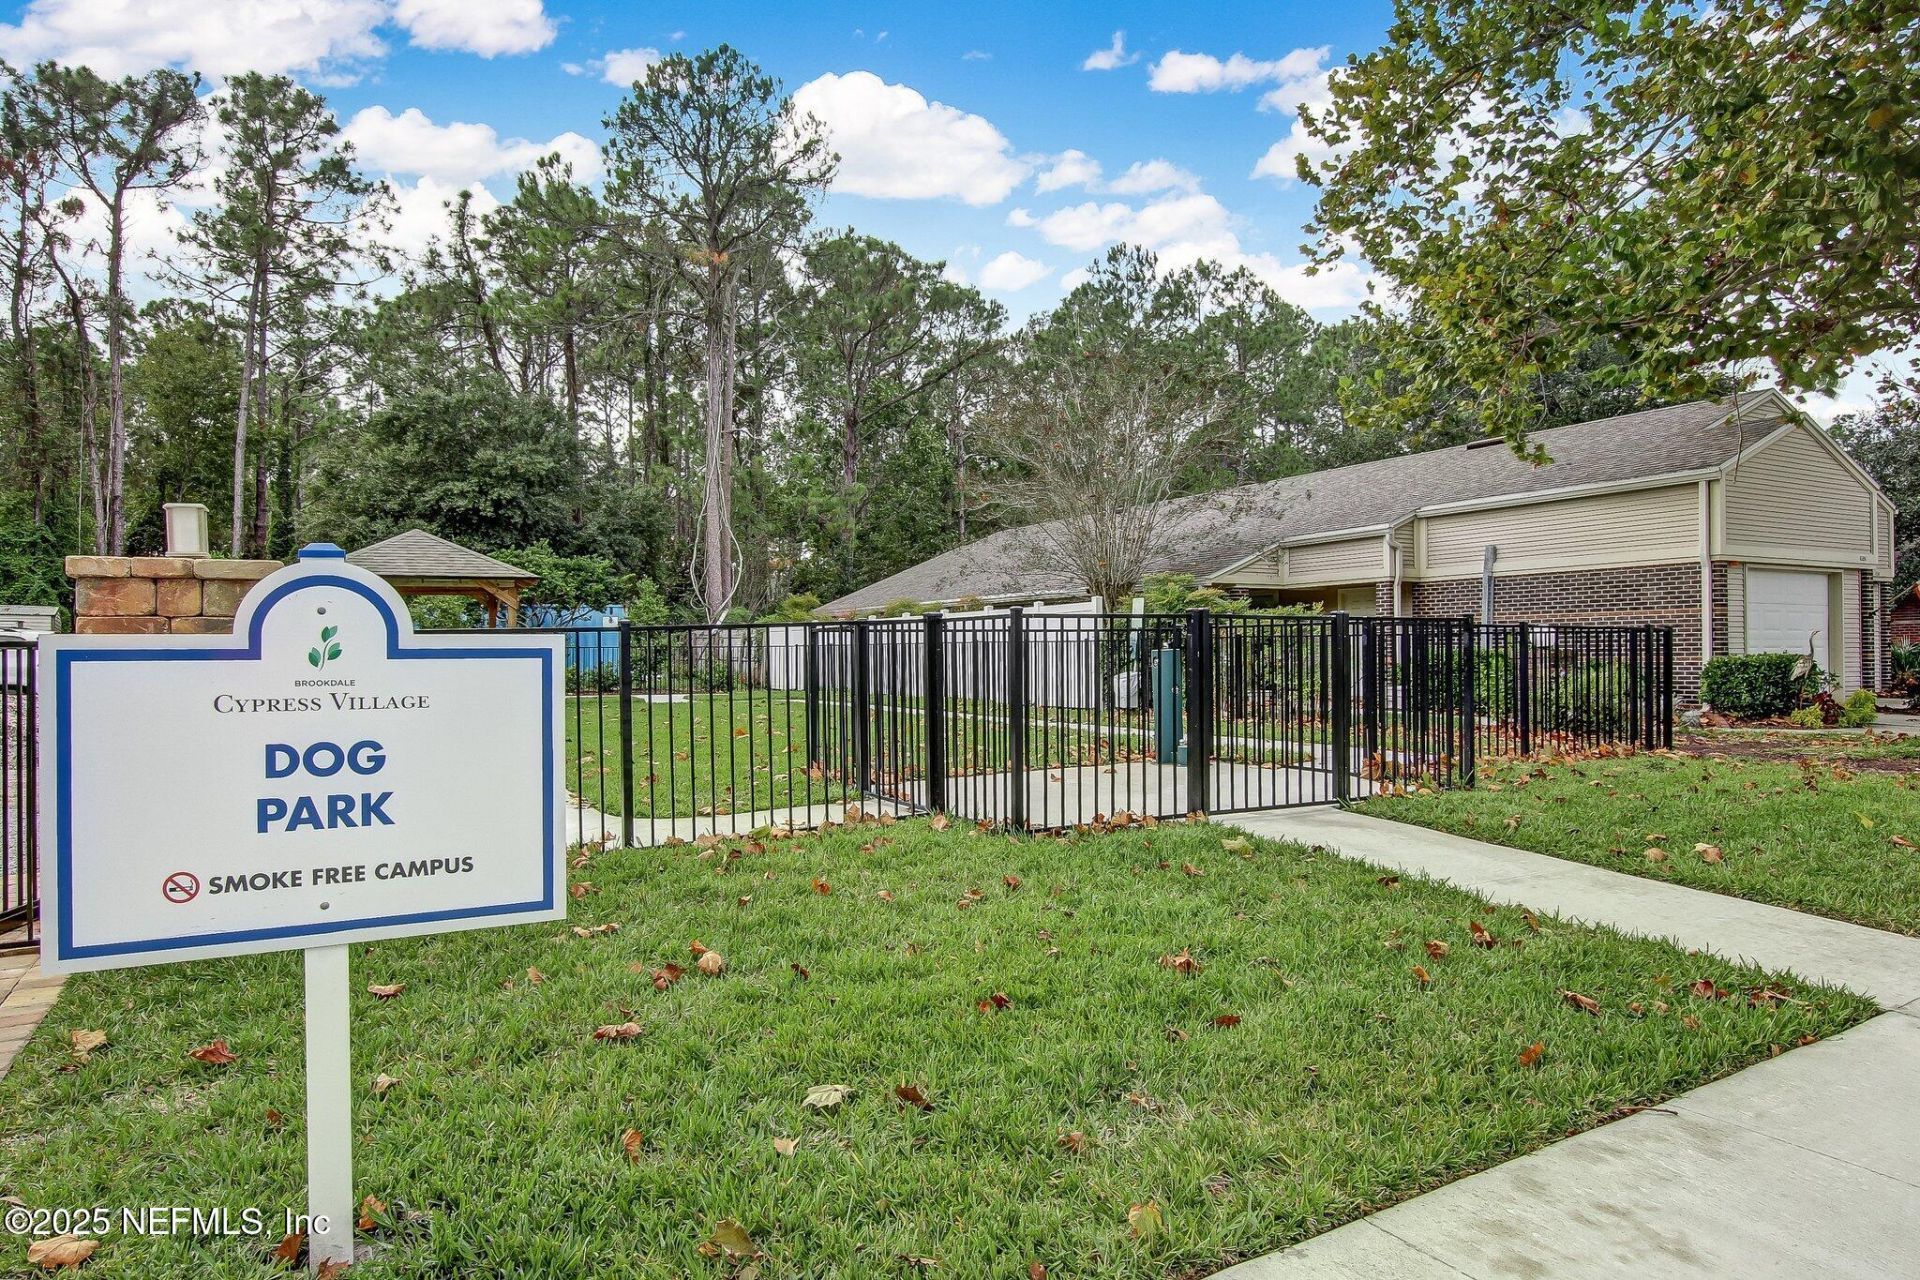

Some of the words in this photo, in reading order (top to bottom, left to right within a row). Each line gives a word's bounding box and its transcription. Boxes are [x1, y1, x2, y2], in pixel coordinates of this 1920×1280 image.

[213, 694, 322, 714] CYPRESS
[329, 692, 430, 711] VILLAGE
[294, 679, 356, 688] BROOKDALE
[265, 739, 387, 779] DOG
[257, 791, 396, 834] PARK
[208, 869, 303, 895] SMOKE
[312, 864, 366, 886] FREE
[374, 856, 475, 881] CAMPUS
